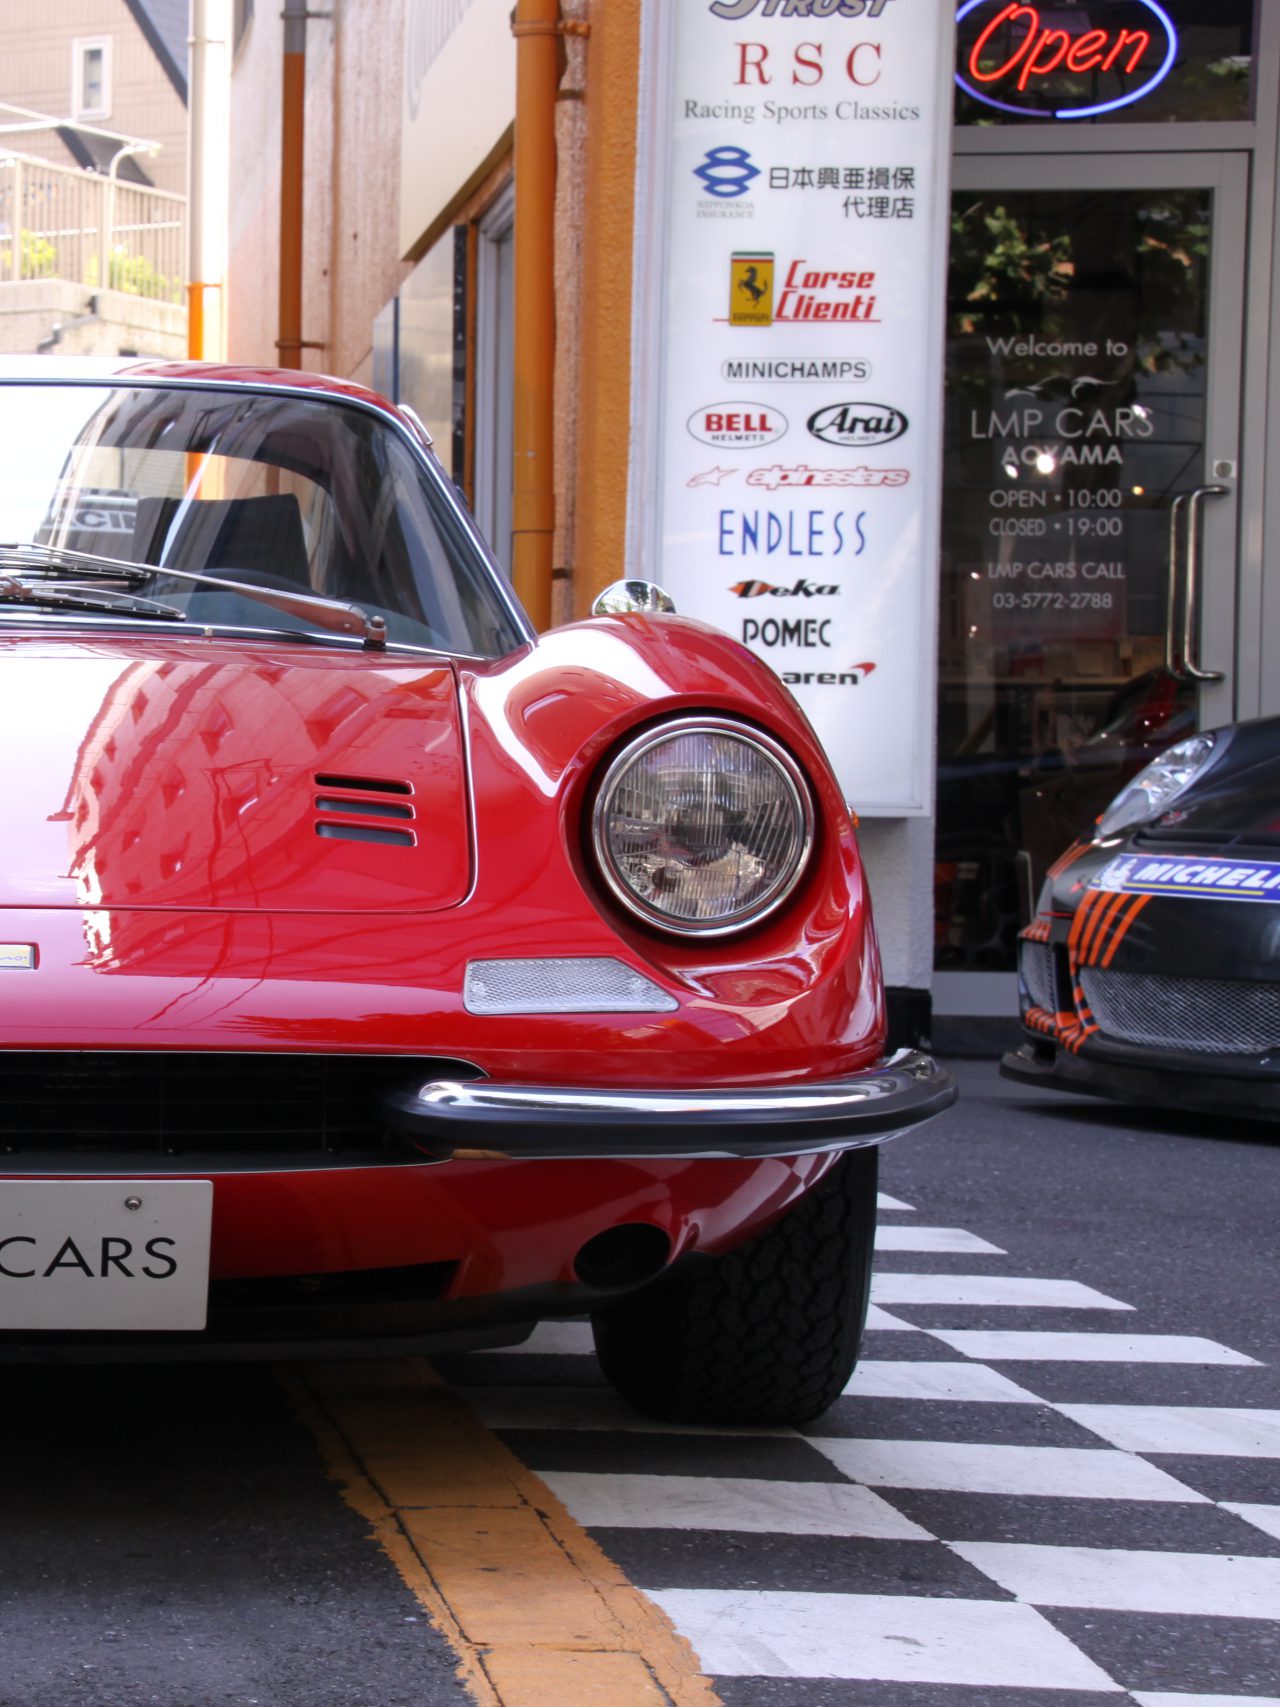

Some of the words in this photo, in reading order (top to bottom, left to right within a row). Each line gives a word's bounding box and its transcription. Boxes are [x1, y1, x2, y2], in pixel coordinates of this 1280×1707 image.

[969, 2, 1150, 91] Open
[684, 100, 755, 123] Racing
[763, 100, 828, 124] Sports
[835, 100, 920, 121] Classics
[769, 166, 915, 191] 日本興亜損保
[842, 195, 915, 220] 代理店
[784, 260, 876, 289] Corse
[775, 290, 877, 320] Clienti
[985, 334, 1098, 357] Welcome
[1105, 339, 1129, 357] to
[726, 361, 867, 379] MINICHAMPS
[705, 413, 773, 432] BELL
[813, 407, 897, 435] Arai
[971, 408, 1043, 439] LMP
[1055, 407, 1154, 439] CARS
[711, 434, 766, 442] HELMETS
[988, 490, 1047, 508] OPEN
[1067, 489, 1123, 508] 10:00
[719, 509, 866, 556] ENDLESS
[988, 518, 1047, 536] CLOSED
[1067, 517, 1123, 536] 19:00
[987, 563, 1023, 580] LMP
[1027, 562, 1077, 580] CARS
[1081, 562, 1126, 580] CALL
[992, 592, 1114, 610] 03-5772-2788
[781, 671, 860, 686] aren
[1132, 862, 1280, 889] MICHELI
